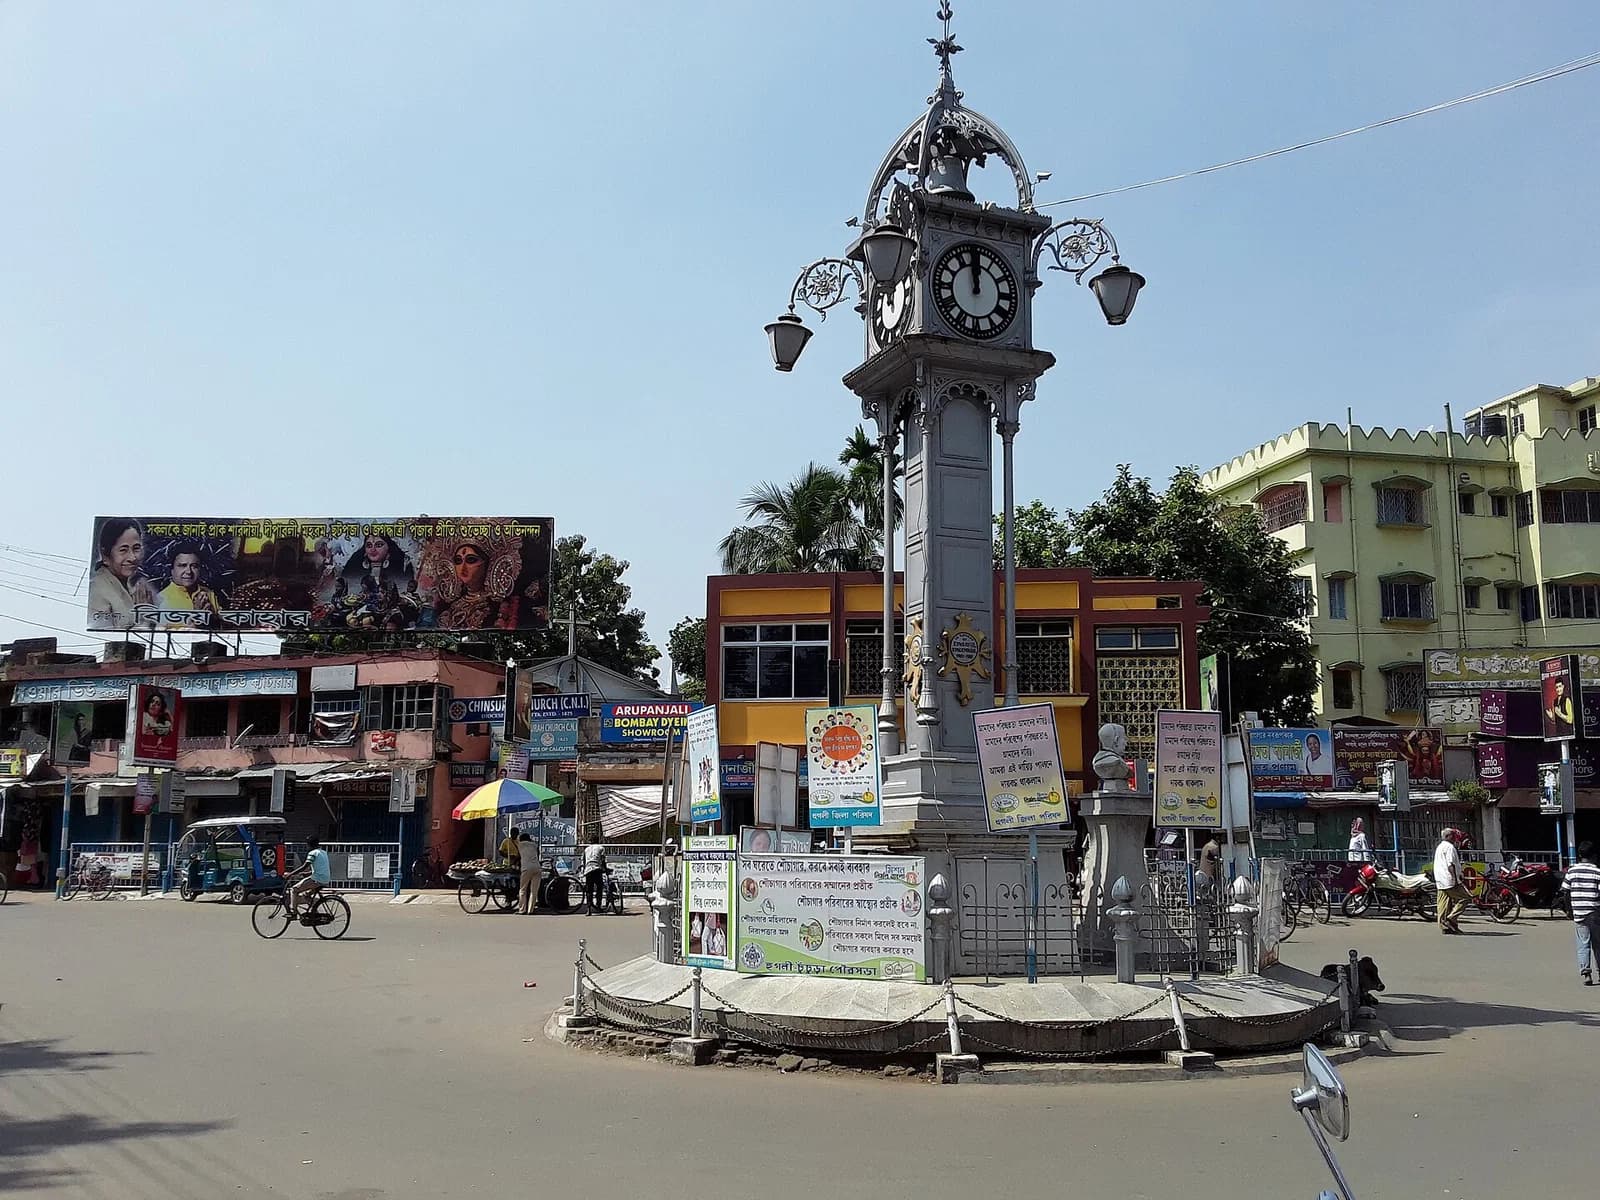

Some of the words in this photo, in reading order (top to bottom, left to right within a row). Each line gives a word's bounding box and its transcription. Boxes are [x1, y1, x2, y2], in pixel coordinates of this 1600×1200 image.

[147, 523, 180, 537] সকলকে
[182, 521, 206, 537] জানাই
[363, 523, 371, 536] ও
[409, 523, 433, 541] পূজার
[460, 522, 491, 539] শুভেচ্ছা
[494, 523, 501, 536] ও
[503, 519, 541, 538] অভিনন্দন
[131, 603, 211, 627] বিজয়
[219, 608, 311, 630] কাহার
[65, 679, 97, 699] ভিউ
[468, 700, 506, 713] CHINSUR
[531, 697, 558, 711] URCH
[560, 695, 589, 711] (C.N.I.)
[615, 704, 688, 716] ARUPANJALI
[1487, 702, 1500, 714] mio
[614, 717, 660, 728] BOMBAY
[661, 717, 688, 727] DYEIN
[1483, 712, 1503, 721] amore
[1484, 755, 1498, 766] mio
[1481, 765, 1502, 775] amore
[1573, 765, 1593, 774] more
[742, 860, 751, 871] সব
[808, 861, 827, 873] করবে
[828, 862, 846, 873] সবাই
[847, 861, 870, 874] ব্যবহার
[759, 878, 787, 889] শৌচাগার
[789, 878, 822, 889] পরিবারের
[852, 878, 873, 891] প্রতীক
[797, 895, 823, 907] শৌচাগার
[825, 896, 854, 908] পরিবারের
[879, 897, 898, 909] প্রতীক
[768, 915, 798, 924] মহিলাদের
[825, 930, 854, 940] পরিবারের
[855, 932, 873, 941] সকলে
[874, 931, 890, 942] মিলে
[829, 964, 877, 976] পৌরসভা
